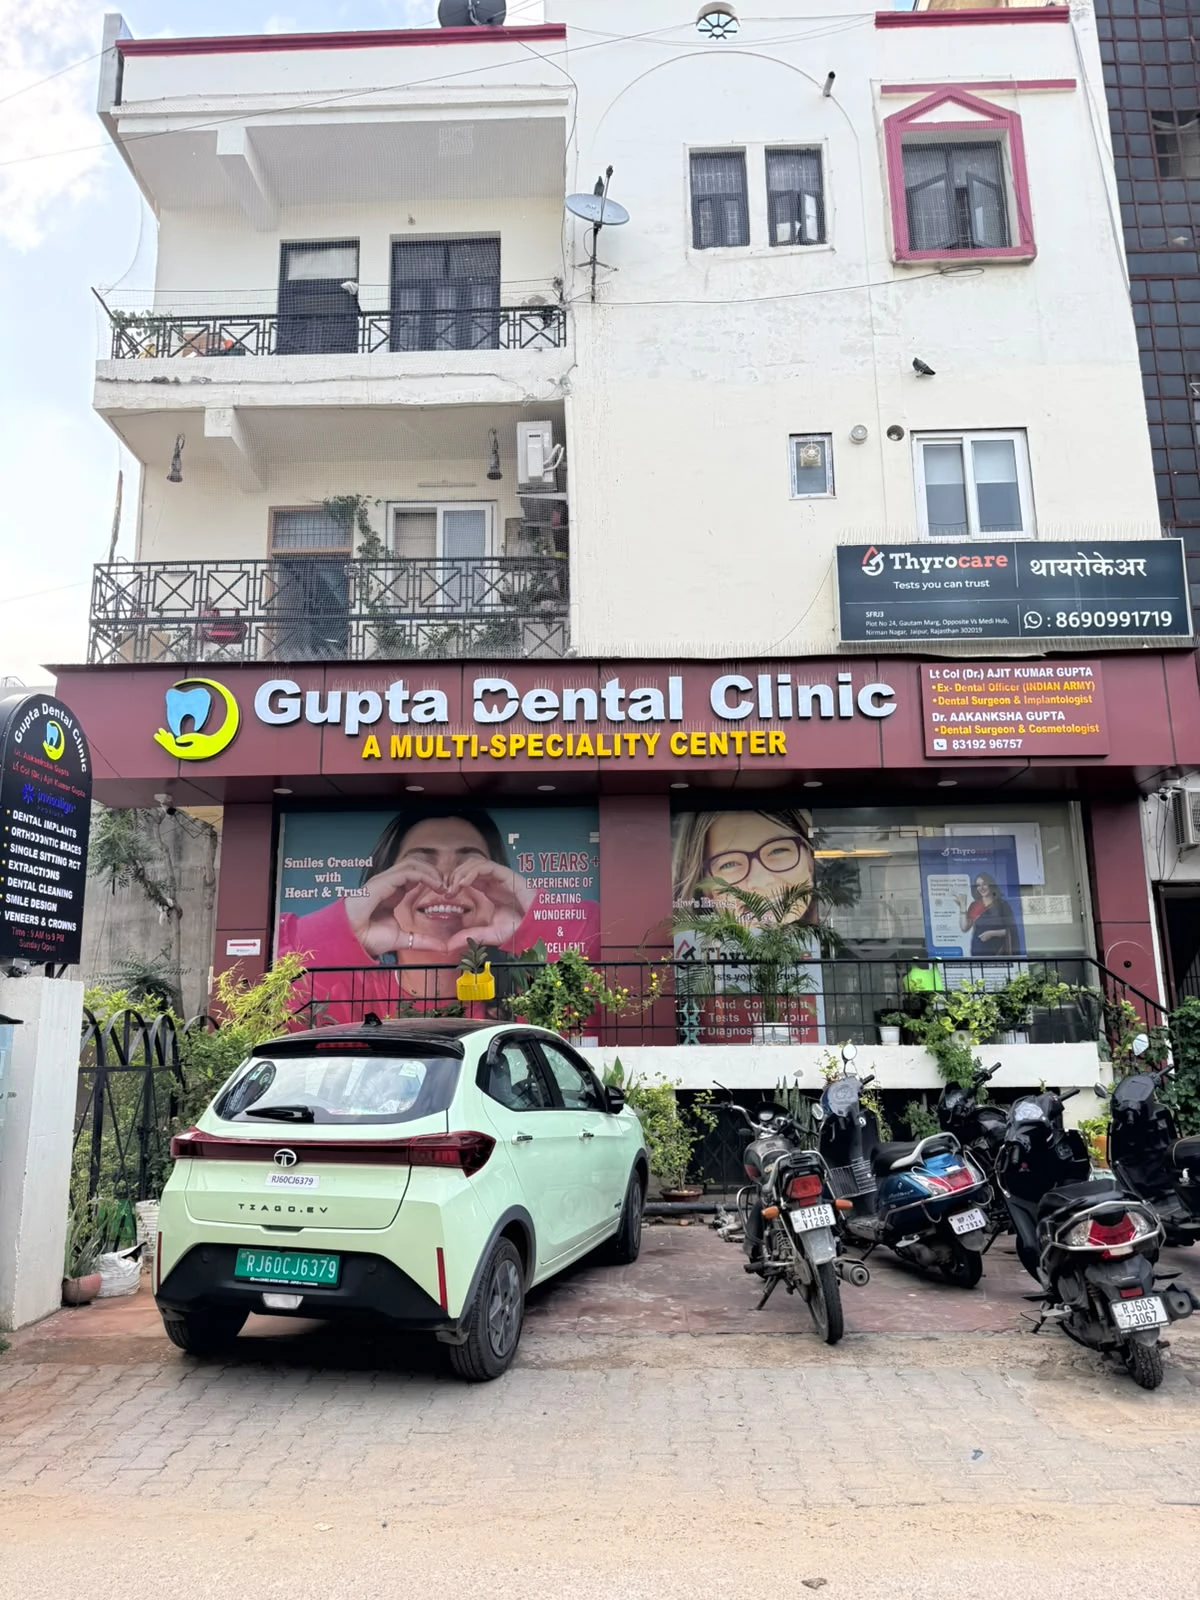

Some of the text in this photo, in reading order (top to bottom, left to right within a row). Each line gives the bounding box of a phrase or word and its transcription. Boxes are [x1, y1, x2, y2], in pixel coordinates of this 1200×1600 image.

[889, 552, 1009, 574] Thyrocare
[1029, 551, 1148, 577] थायरोकेअर
[893, 578, 990, 591] Tests you can trust
[888, 620, 898, 628] 24,
[898, 619, 922, 627] Gautam
[923, 619, 941, 627] Marg,
[942, 618, 970, 626] Opposite
[978, 617, 994, 625] Medi
[995, 616, 1010, 625] Hub,
[1055, 610, 1173, 628] 8690991719
[888, 629, 908, 637] Nagar,
[930, 627, 960, 635] Rajasthan
[960, 626, 983, 634] 302019
[929, 667, 1093, 680] Lt Col (Dr.) AJIT KUMAR GUPTA
[954, 683, 986, 692] Dental
[988, 683, 1019, 692] Officer
[1022, 682, 1061, 692] (INDIAN
[1063, 681, 1095, 691] ARMY)
[254, 671, 897, 735] Gupta Dental Clinic
[938, 695, 1093, 707] Dental Surgeon & Implantologist
[932, 711, 1065, 722] Dr. AAKANKSHA GUPTA
[940, 724, 1100, 736] Dental Surgeon & Cosmetologist
[14, 703, 88, 773] Gupta Dental Clinic
[361, 730, 788, 759] A MULTI-SPECIALITY CENTER
[952, 740, 1023, 749] 83192 96757
[12, 809, 43, 828] DENTAL
[43, 819, 77, 839] IMPLANTS
[11, 826, 82, 856] ORTHODONTIC BRACES
[9, 843, 82, 871] SINGLE SITTING RCT
[284, 856, 374, 868] Smiles Created
[516, 852, 535, 873] 15
[538, 851, 589, 873] YEARS
[8, 859, 61, 881] EXTRACTIONS
[315, 871, 342, 883] with
[526, 876, 594, 889] EXPERIENCE OF
[7, 876, 73, 900] DENTAL CLEANING
[284, 885, 370, 898] Heart & Trust.
[5, 893, 58, 913] SMILE DESIGN
[538, 893, 582, 904] CREATING
[4, 910, 77, 932] VENEERS & CROWNS
[533, 909, 588, 921] WONDERFUL
[556, 925, 565, 937] &
[715, 999, 736, 1010] And
[708, 1012, 740, 1023] Tests
[271, 1175, 314, 1185] RJ60CJ6379
[238, 1203, 328, 1214] TIAGO.EV
[246, 1253, 337, 1279] RJ60CJ6379
[1121, 1298, 1155, 1315] RJ60S
